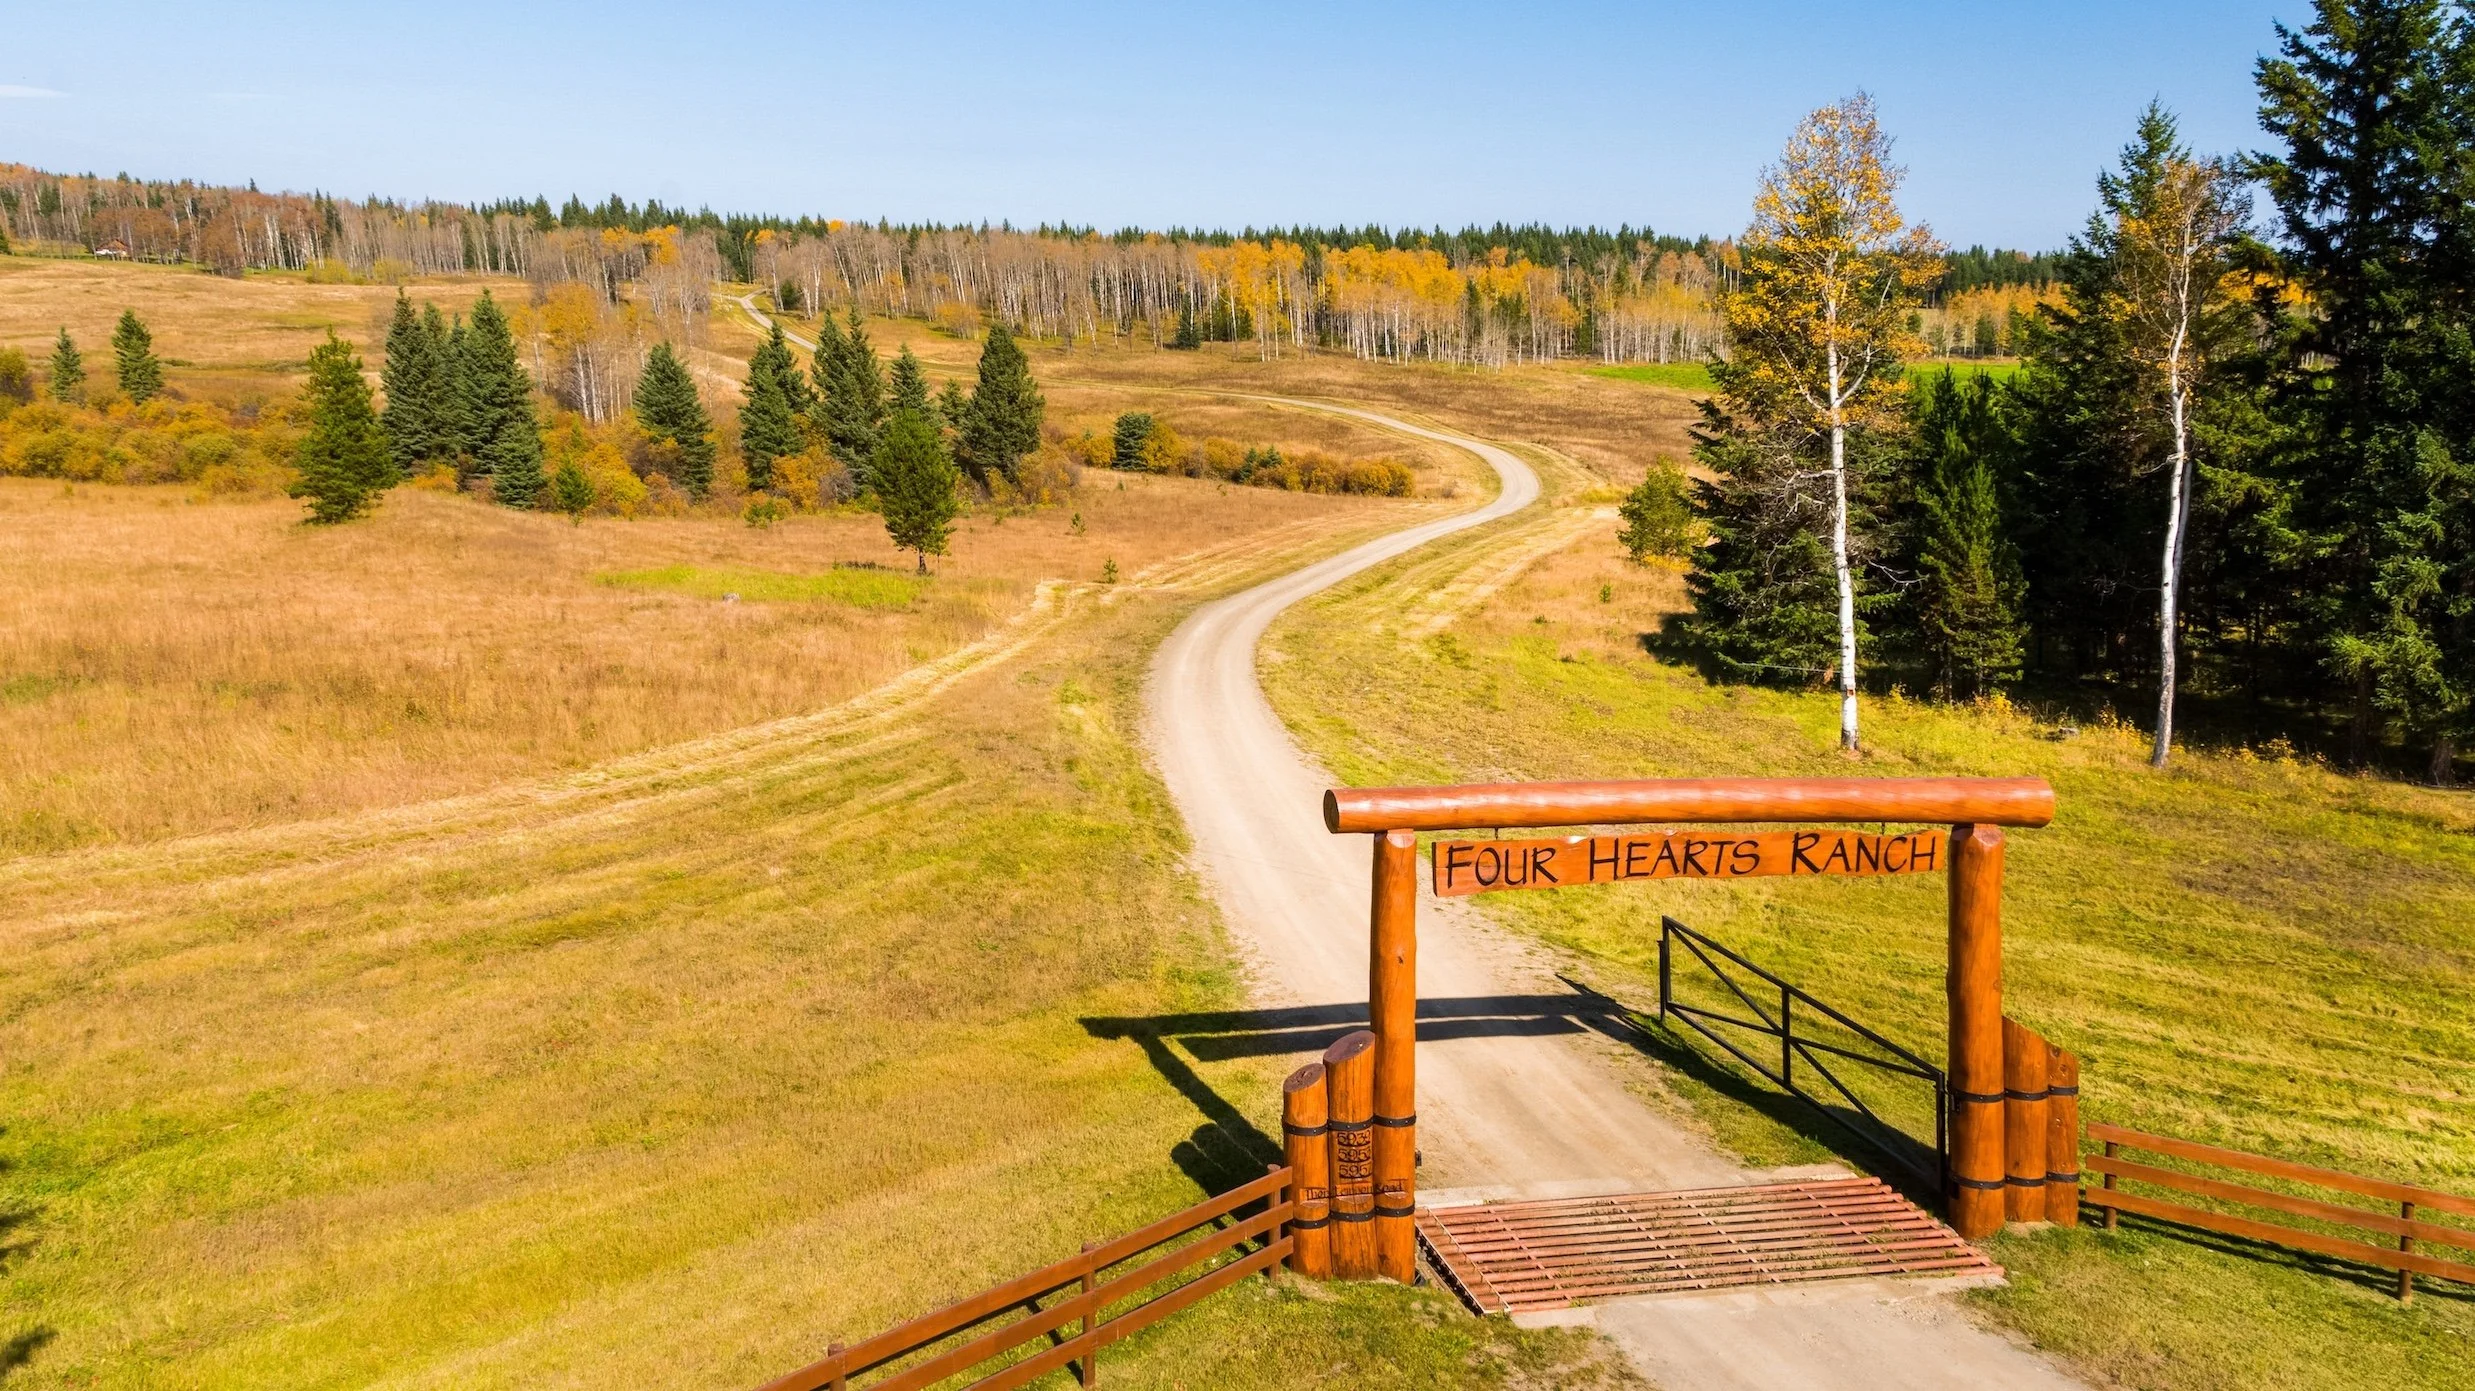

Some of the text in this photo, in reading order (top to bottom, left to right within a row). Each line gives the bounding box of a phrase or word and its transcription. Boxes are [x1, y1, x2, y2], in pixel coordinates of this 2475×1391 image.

[1446, 831, 1937, 888] FOUR HEARTS RANCH
